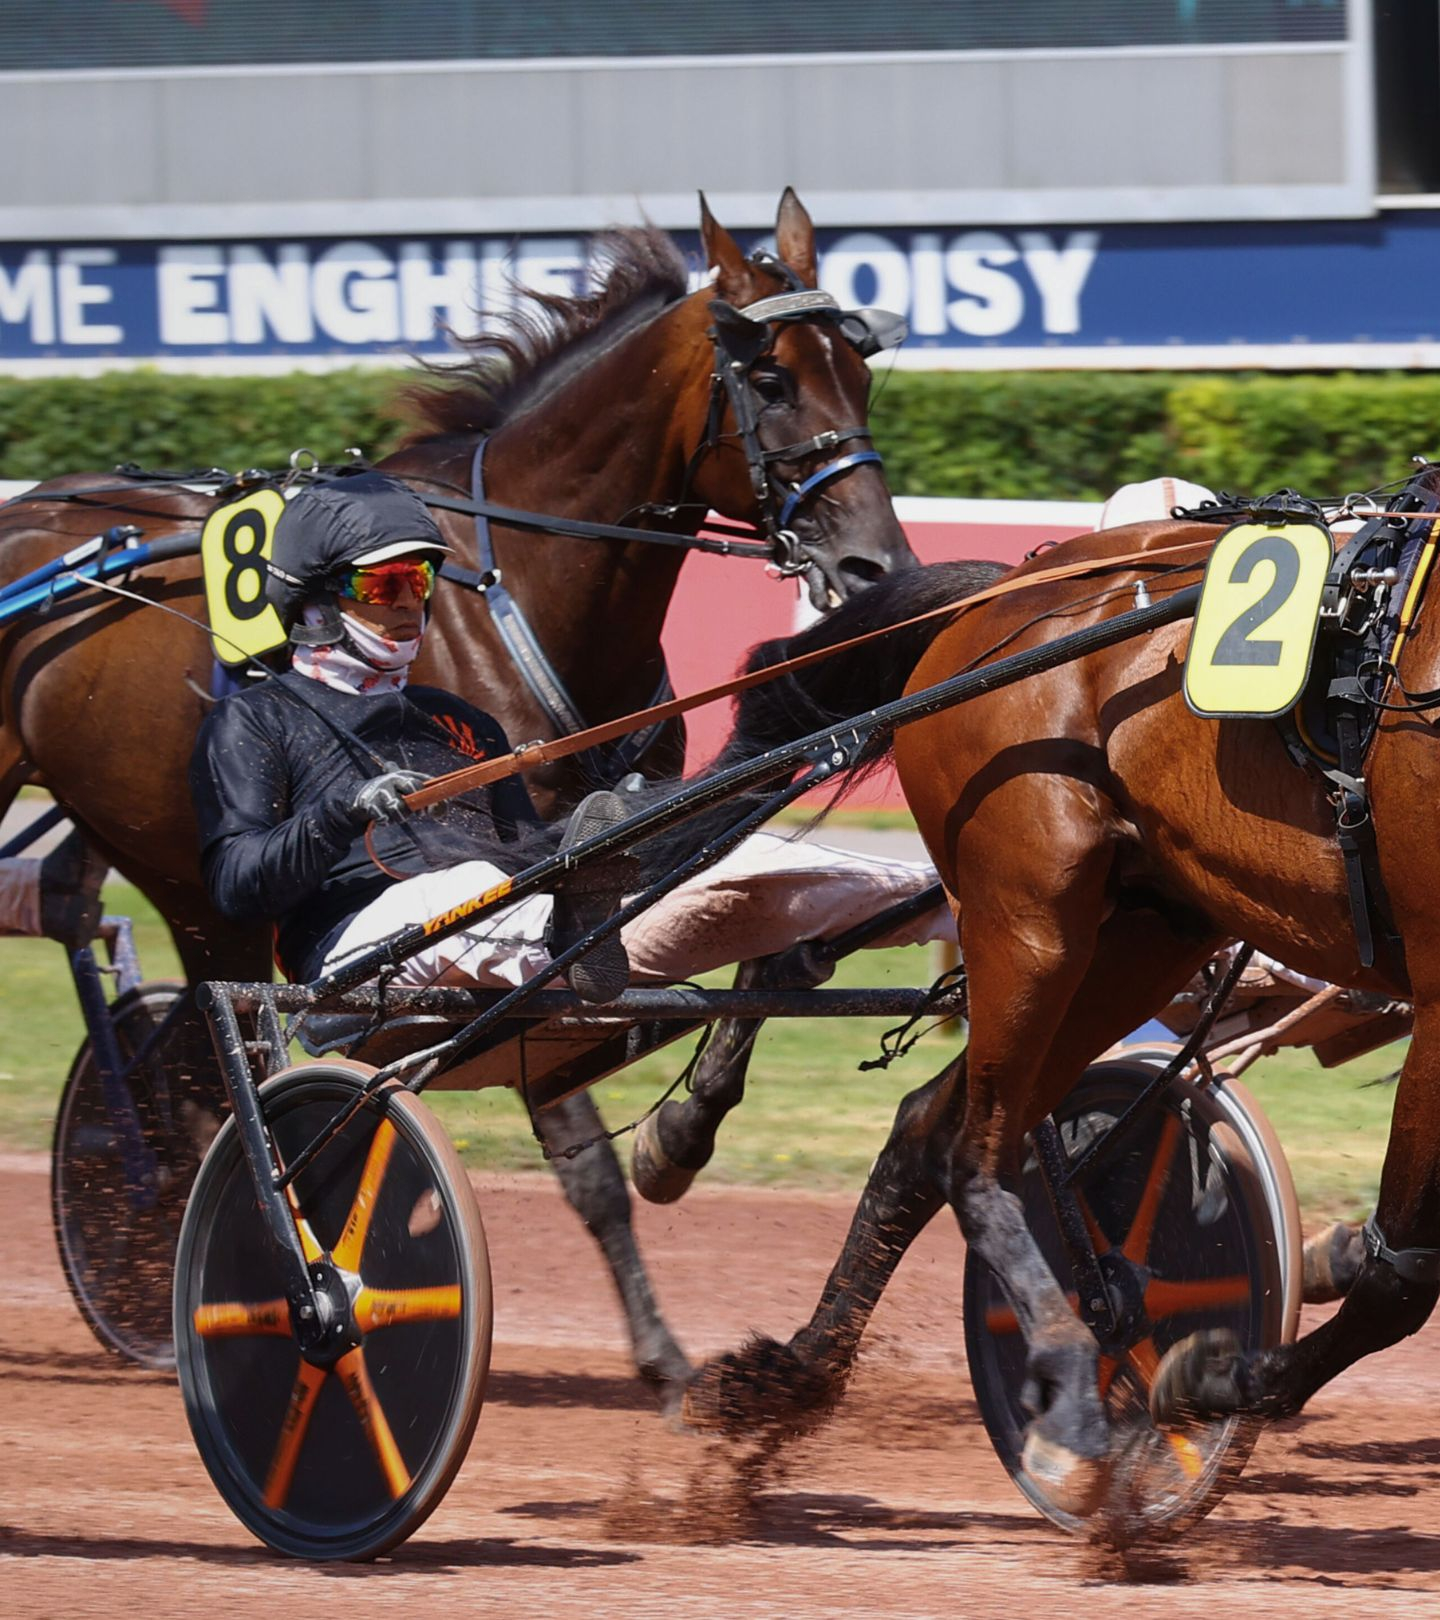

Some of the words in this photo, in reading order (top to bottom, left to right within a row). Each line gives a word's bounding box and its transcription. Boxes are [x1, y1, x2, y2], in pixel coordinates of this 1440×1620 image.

[224, 508, 268, 621] 8
[1211, 536, 1300, 666] 2
[423, 877, 514, 937] YANKEE
